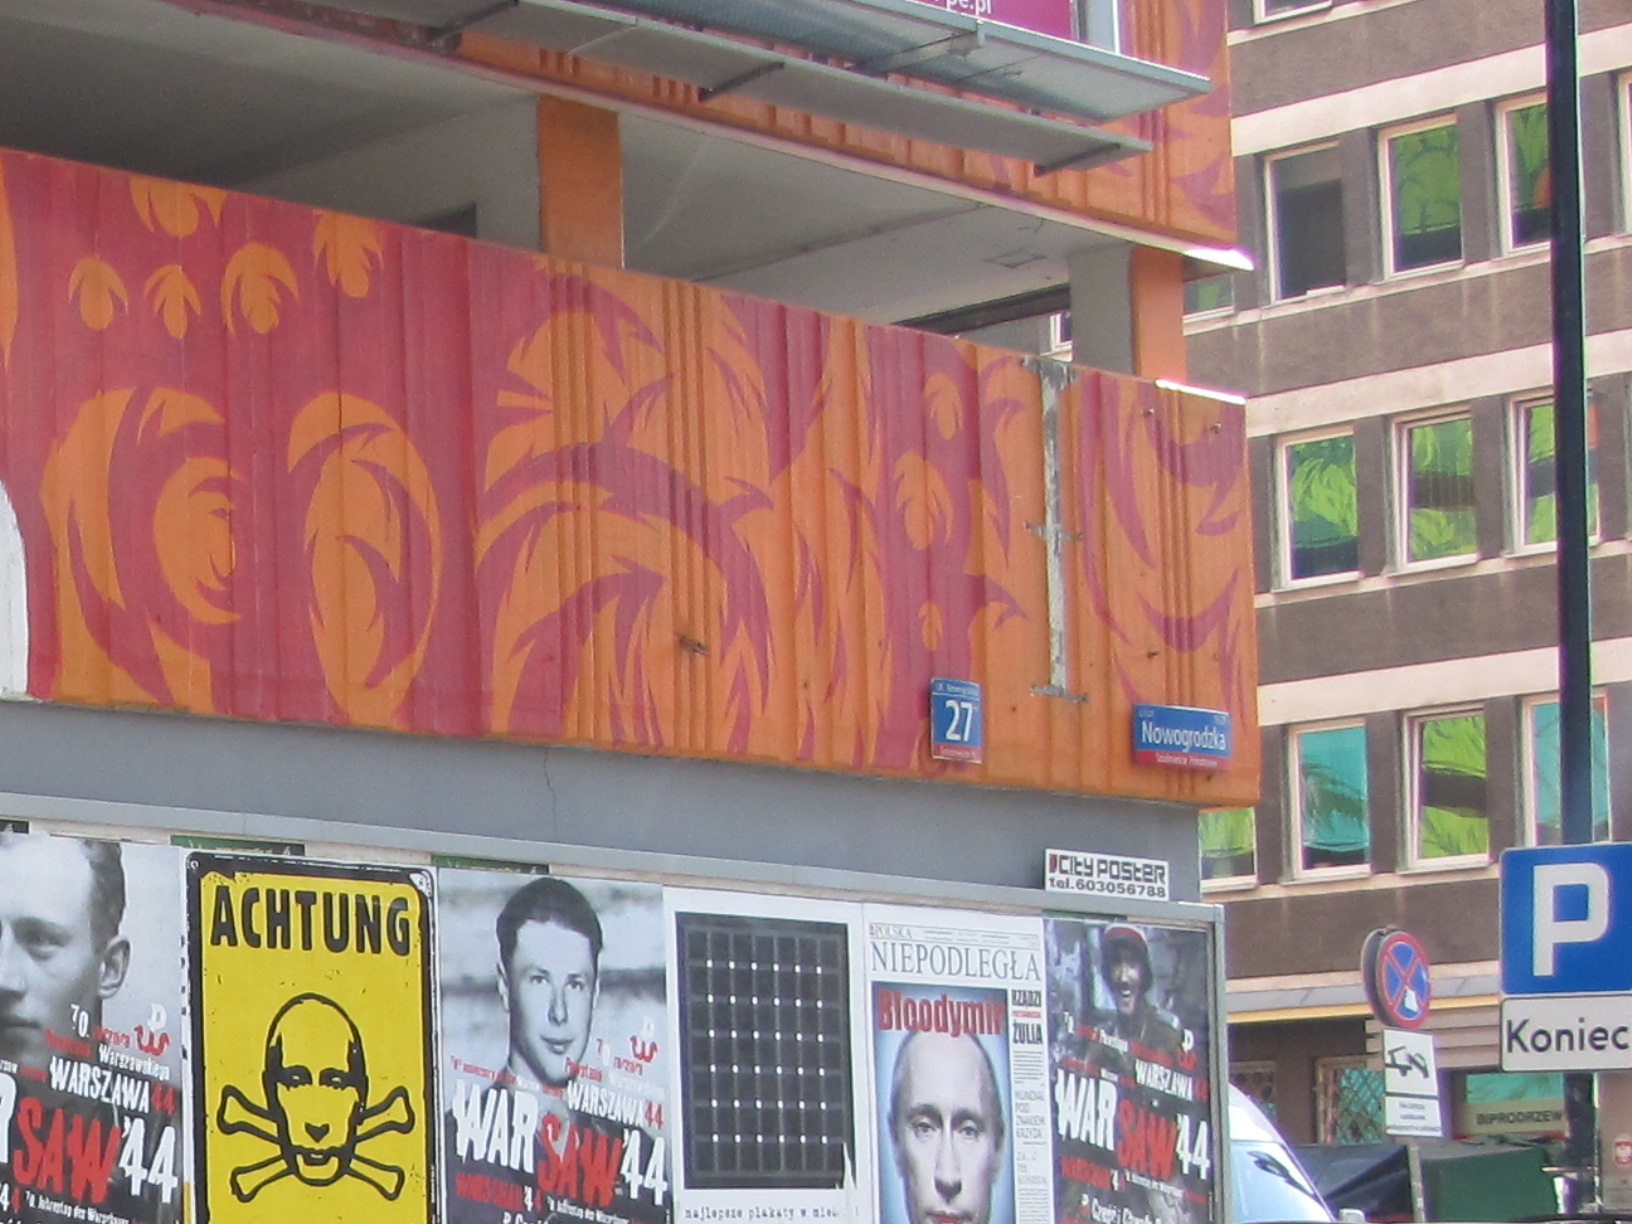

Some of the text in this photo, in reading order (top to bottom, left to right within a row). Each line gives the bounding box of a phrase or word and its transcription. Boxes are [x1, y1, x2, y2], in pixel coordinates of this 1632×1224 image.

[946, 700, 972, 742] 27
[1141, 720, 1226, 753] Nowogrodzka
[1049, 877, 1166, 898] tel.603056788
[209, 884, 411, 957] ACHTUNG
[1533, 862, 1610, 977] P
[870, 941, 1041, 981] NIEPODLEGŁA
[878, 989, 1005, 1038] Bloodymir
[1505, 1017, 1631, 1054] Koniec
[50, 1056, 150, 1114] WARSZAWA
[568, 1080, 645, 1127] WARSZAWA
